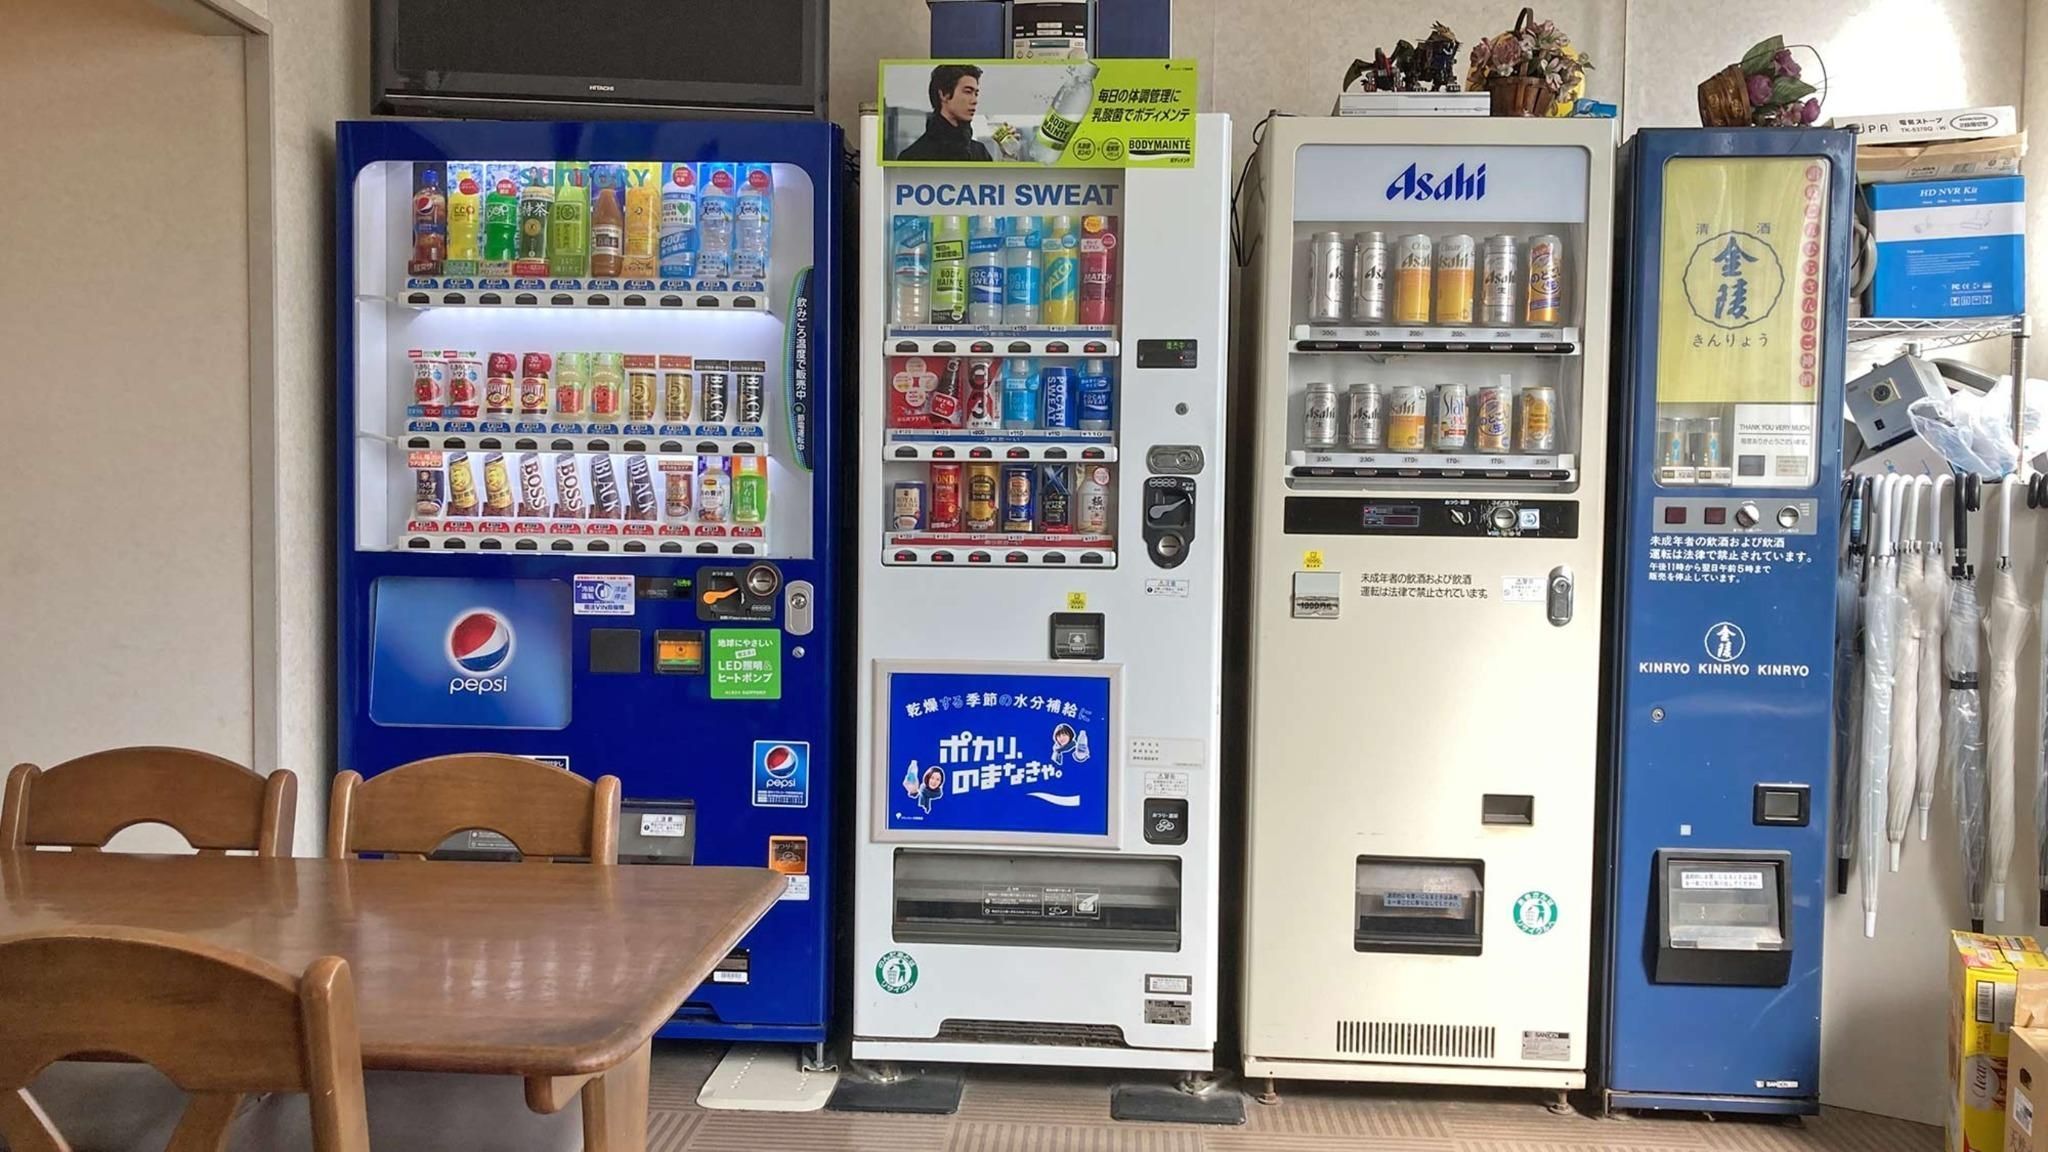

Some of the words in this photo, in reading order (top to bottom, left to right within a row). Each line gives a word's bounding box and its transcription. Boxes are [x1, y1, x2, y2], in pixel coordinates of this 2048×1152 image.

[1098, 88, 1181, 103] 毎日の体調管理に
[1092, 107, 1191, 122] 乳酸菌でボディメンテ
[1386, 162, 1487, 201] Asahi
[896, 184, 1005, 205] POCARI
[1015, 185, 1119, 206] SWEAT
[1920, 189, 1937, 197] HD
[1939, 188, 1961, 196] NVR
[1963, 186, 1978, 195] Kit
[1757, 222, 1771, 235] 酒
[1692, 333, 1769, 348] きんりょう
[710, 374, 724, 419] BLACK
[746, 374, 760, 424] BLACK
[1047, 376, 1057, 422] SWEAT
[1056, 375, 1066, 427] POCARI
[1305, 406, 1336, 420] Asahi
[524, 461, 547, 511] BOSS
[561, 462, 583, 511] BOSS
[594, 458, 619, 513] BLACK
[630, 457, 653, 514] BLACK
[1649, 535, 1786, 548] 未成年者の飲酒および飲酒
[1649, 548, 1813, 564] 運転は法律で禁止されています。
[1649, 563, 1772, 574] 午後11時から翌日午前5時まで
[1360, 573, 1472, 586] 未成年者の飲酒および飲酒
[1649, 572, 1741, 584] 販売を停止しています。
[1360, 586, 1489, 599] 運転は法律で禁止されています。
[717, 638, 774, 648] 地球にやさしい
[1639, 662, 1690, 674] KINRYO
[1698, 663, 1750, 675] KINRYO
[1757, 664, 1810, 677] KINRYO
[449, 676, 508, 695] pepsi
[717, 673, 774, 684] ヒートポンプ
[905, 691, 1093, 723] 乾燥する季節の水分補給に
[766, 779, 796, 788] pepsi
[951, 760, 1063, 795] のまなきゃ。
